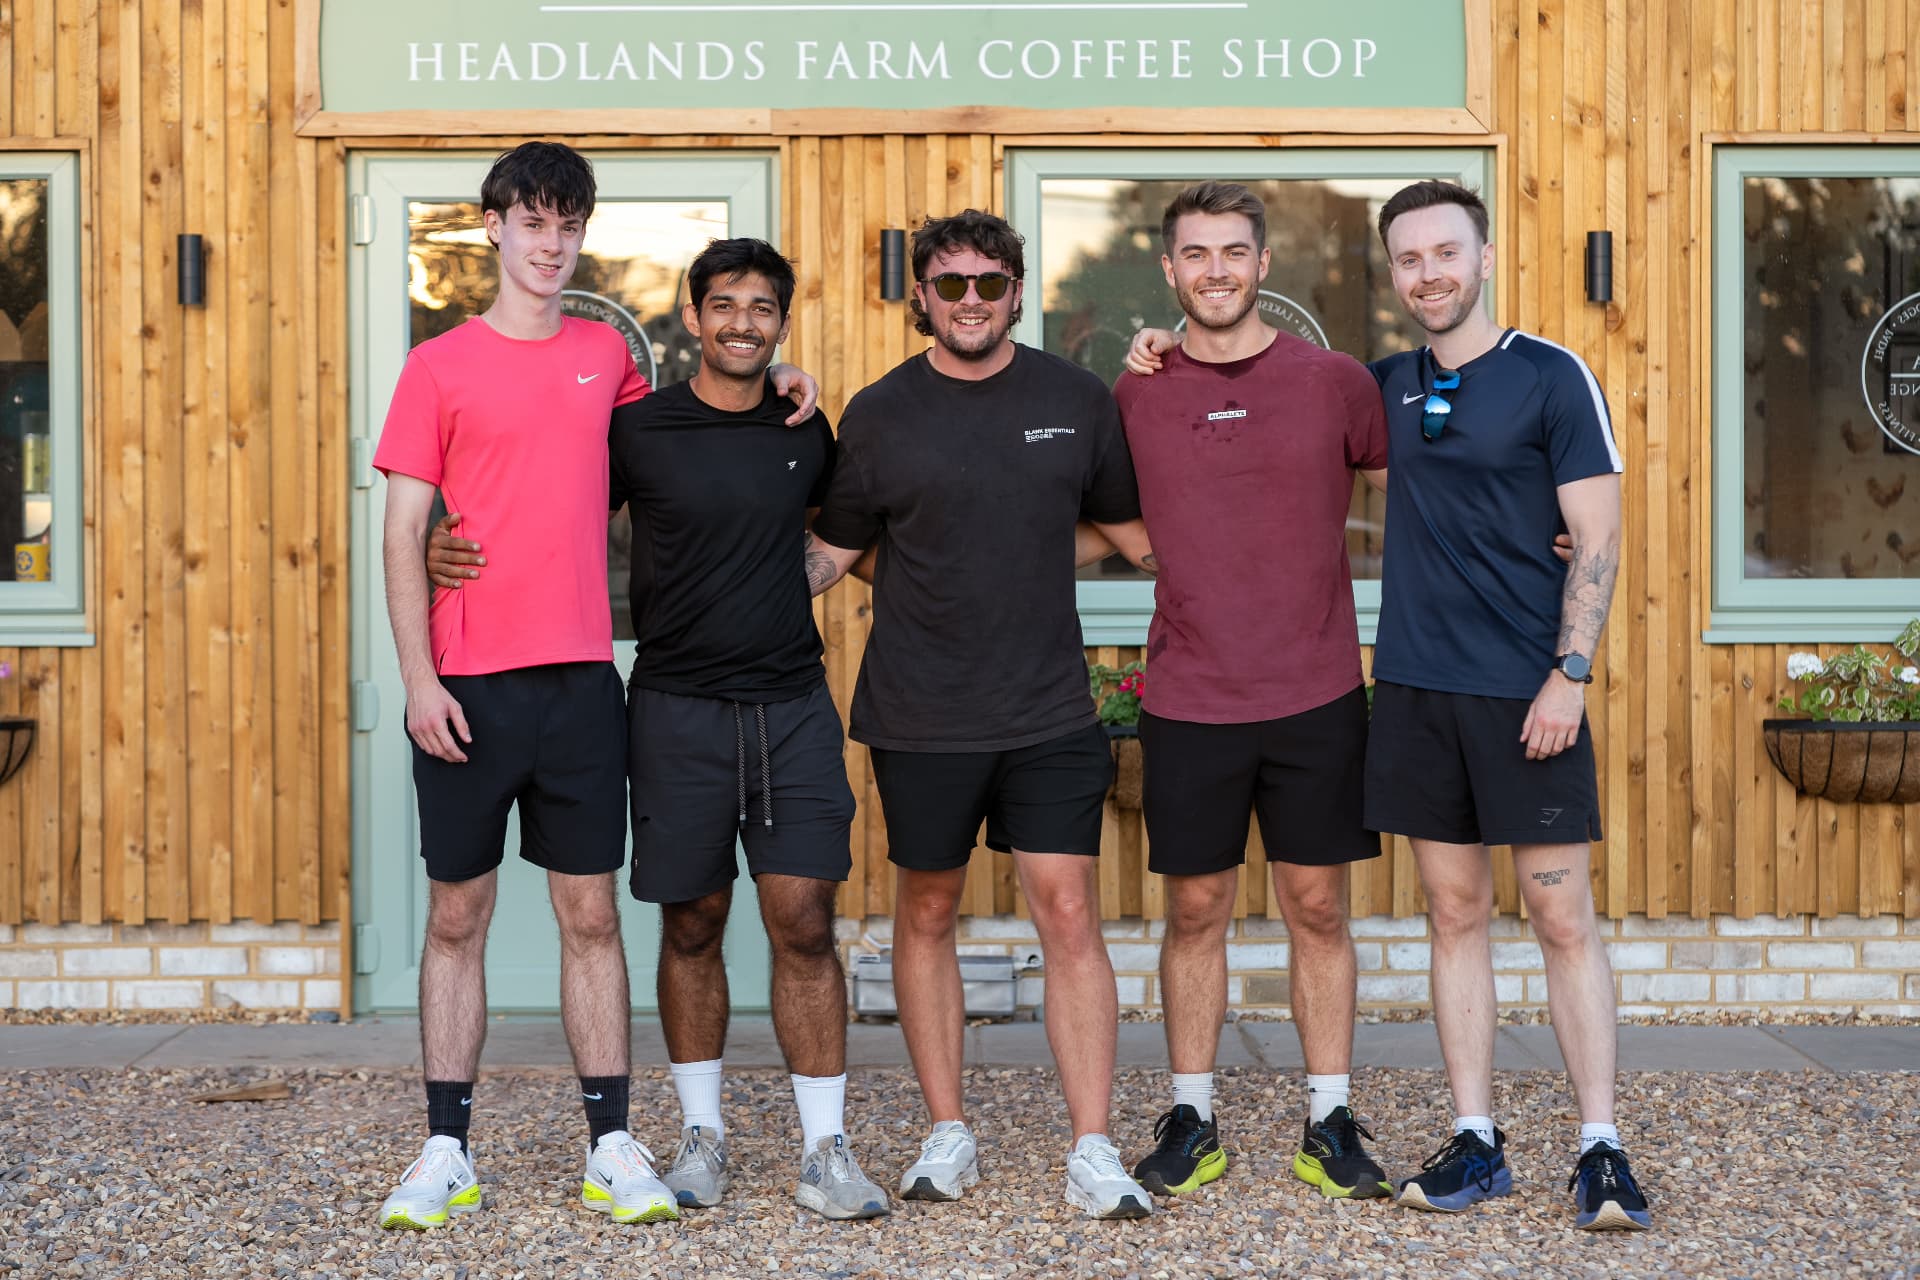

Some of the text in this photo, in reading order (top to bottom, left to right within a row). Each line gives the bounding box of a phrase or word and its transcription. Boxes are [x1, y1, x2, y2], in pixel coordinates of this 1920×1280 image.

[407, 38, 1378, 82] HEADLANDS FARM COFFEE SHOP
[1531, 868, 1570, 880] MEMENTO
